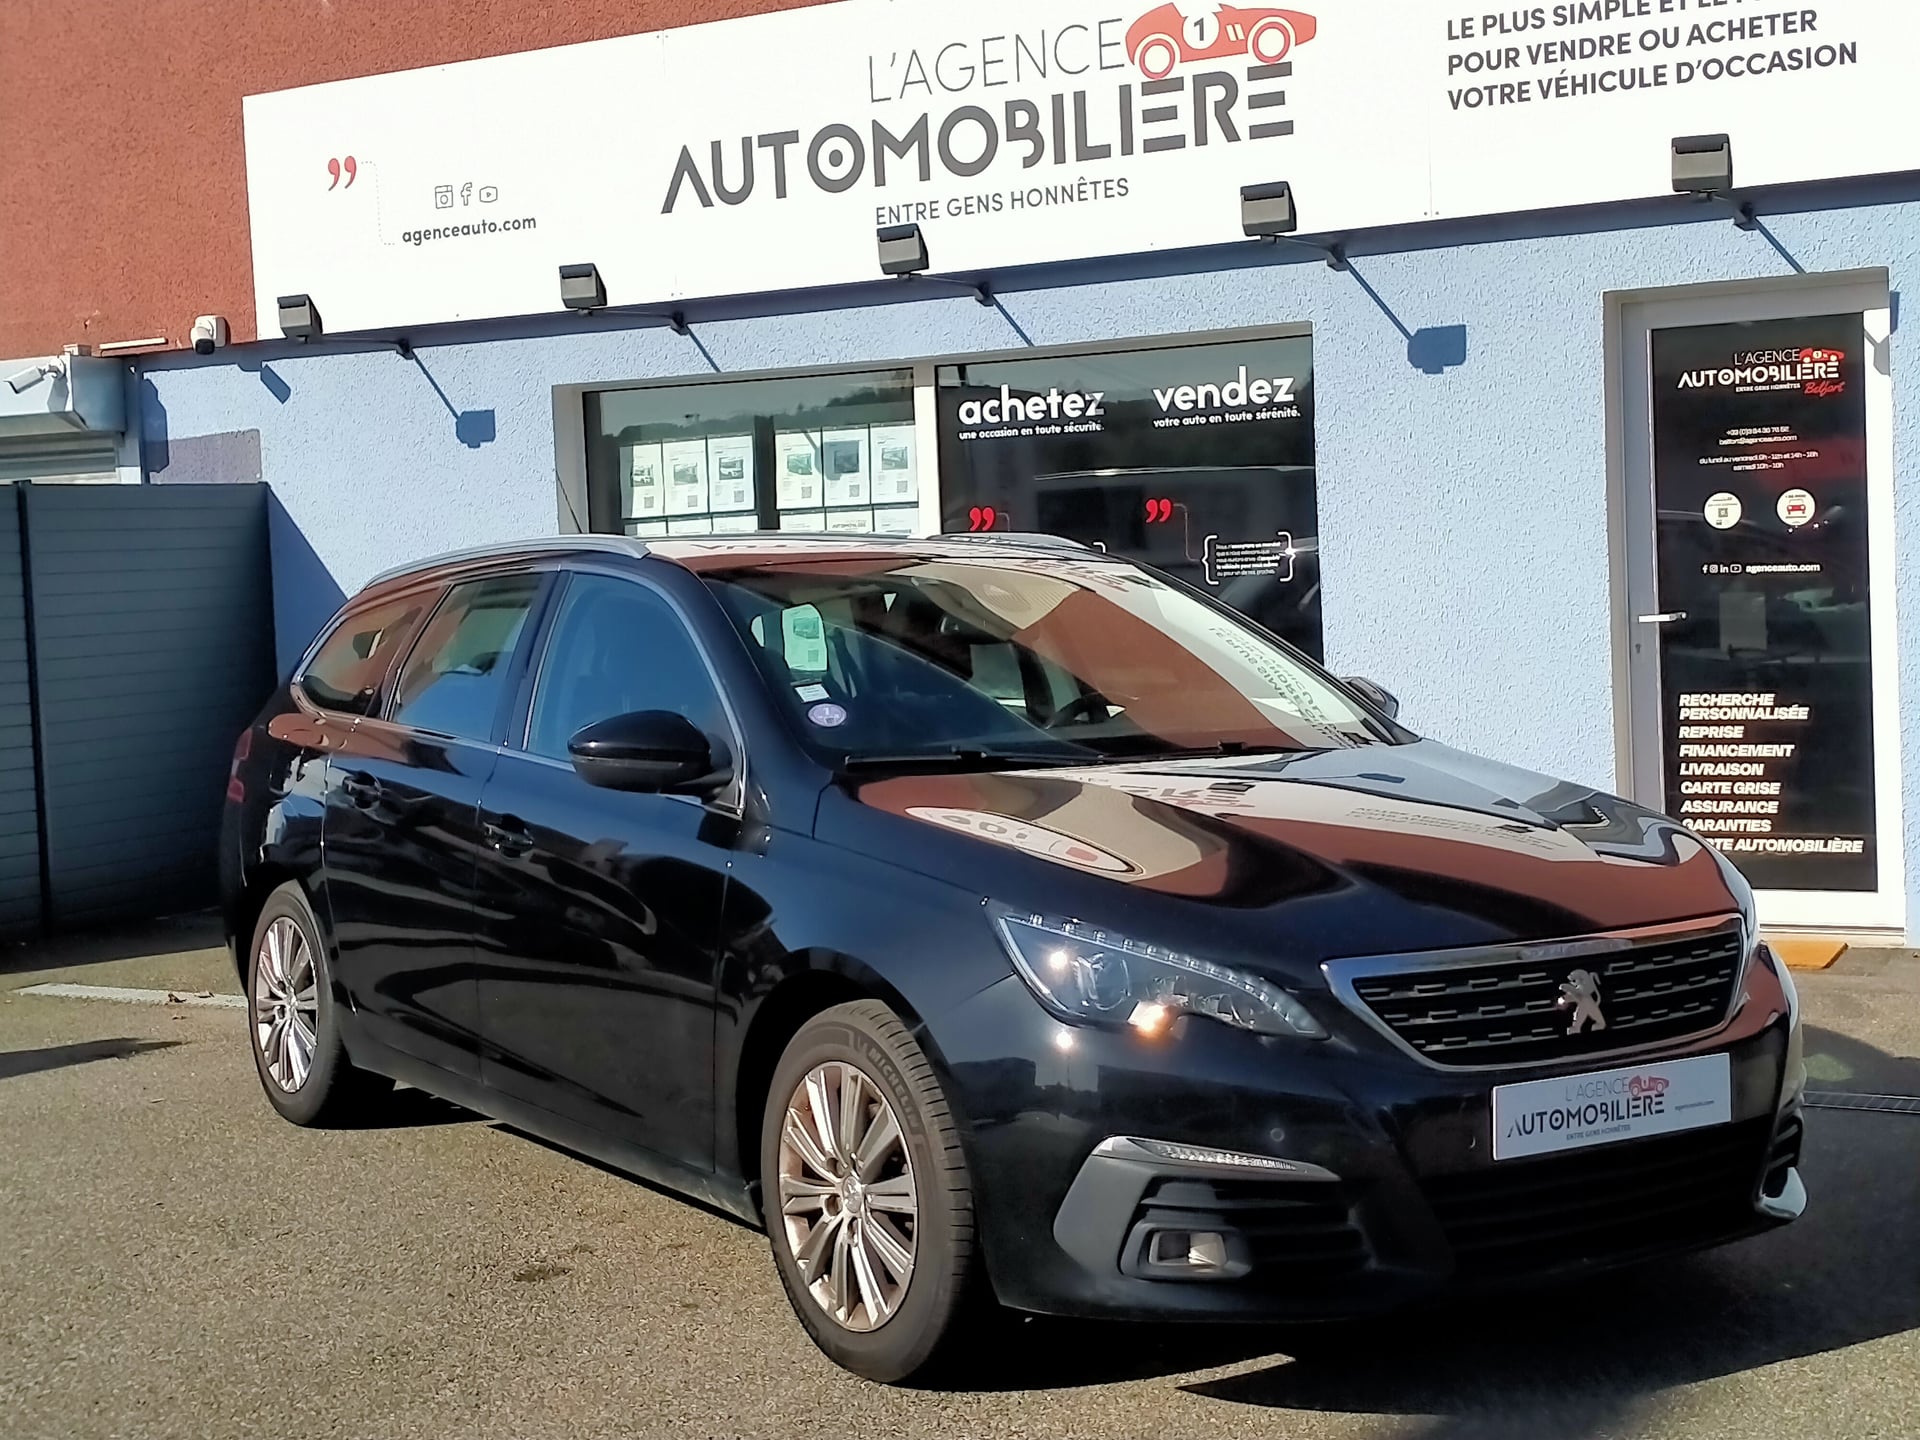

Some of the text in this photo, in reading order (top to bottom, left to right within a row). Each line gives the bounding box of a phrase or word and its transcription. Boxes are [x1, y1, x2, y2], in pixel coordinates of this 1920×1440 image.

[1447, 17, 1474, 41] LE
[1482, 7, 1545, 36] PLUS
[1552, 0, 1651, 27] SIMPLE
[1447, 9, 1818, 76] POUR VENDRE OU ACHETER
[868, 18, 1126, 103] L'AGENCE
[1447, 41, 1857, 111] VOTRE VÉHICULE D'OCCASION
[876, 175, 1130, 226] ENTRE GENS HONNÊTES
[402, 214, 537, 246] agenceauto.com
[1734, 348, 1800, 366] L'AGENCE
[1153, 365, 1295, 412] vendez
[1804, 380, 1846, 397] Belfort
[958, 384, 1105, 425] achetez
[1153, 406, 1301, 428] votre auto en toute sérénité.
[959, 431, 977, 440] une
[979, 426, 1019, 439] occasion
[1020, 427, 1033, 436] en
[1035, 424, 1061, 435] toute
[1679, 693, 1775, 707] RECHERCHE
[1679, 704, 1810, 721] PERSONNALISÉE
[1678, 725, 1745, 739] REPRISE
[1679, 744, 1795, 758] FINANCEMENT
[1679, 763, 1764, 776] LIVRAISON
[1680, 781, 1781, 795] CARTE GRISE
[1680, 800, 1780, 814] ASSURANCE
[1682, 818, 1772, 832] GARANTIES
[1732, 836, 1864, 853] AUTOMOBILIÈRE
